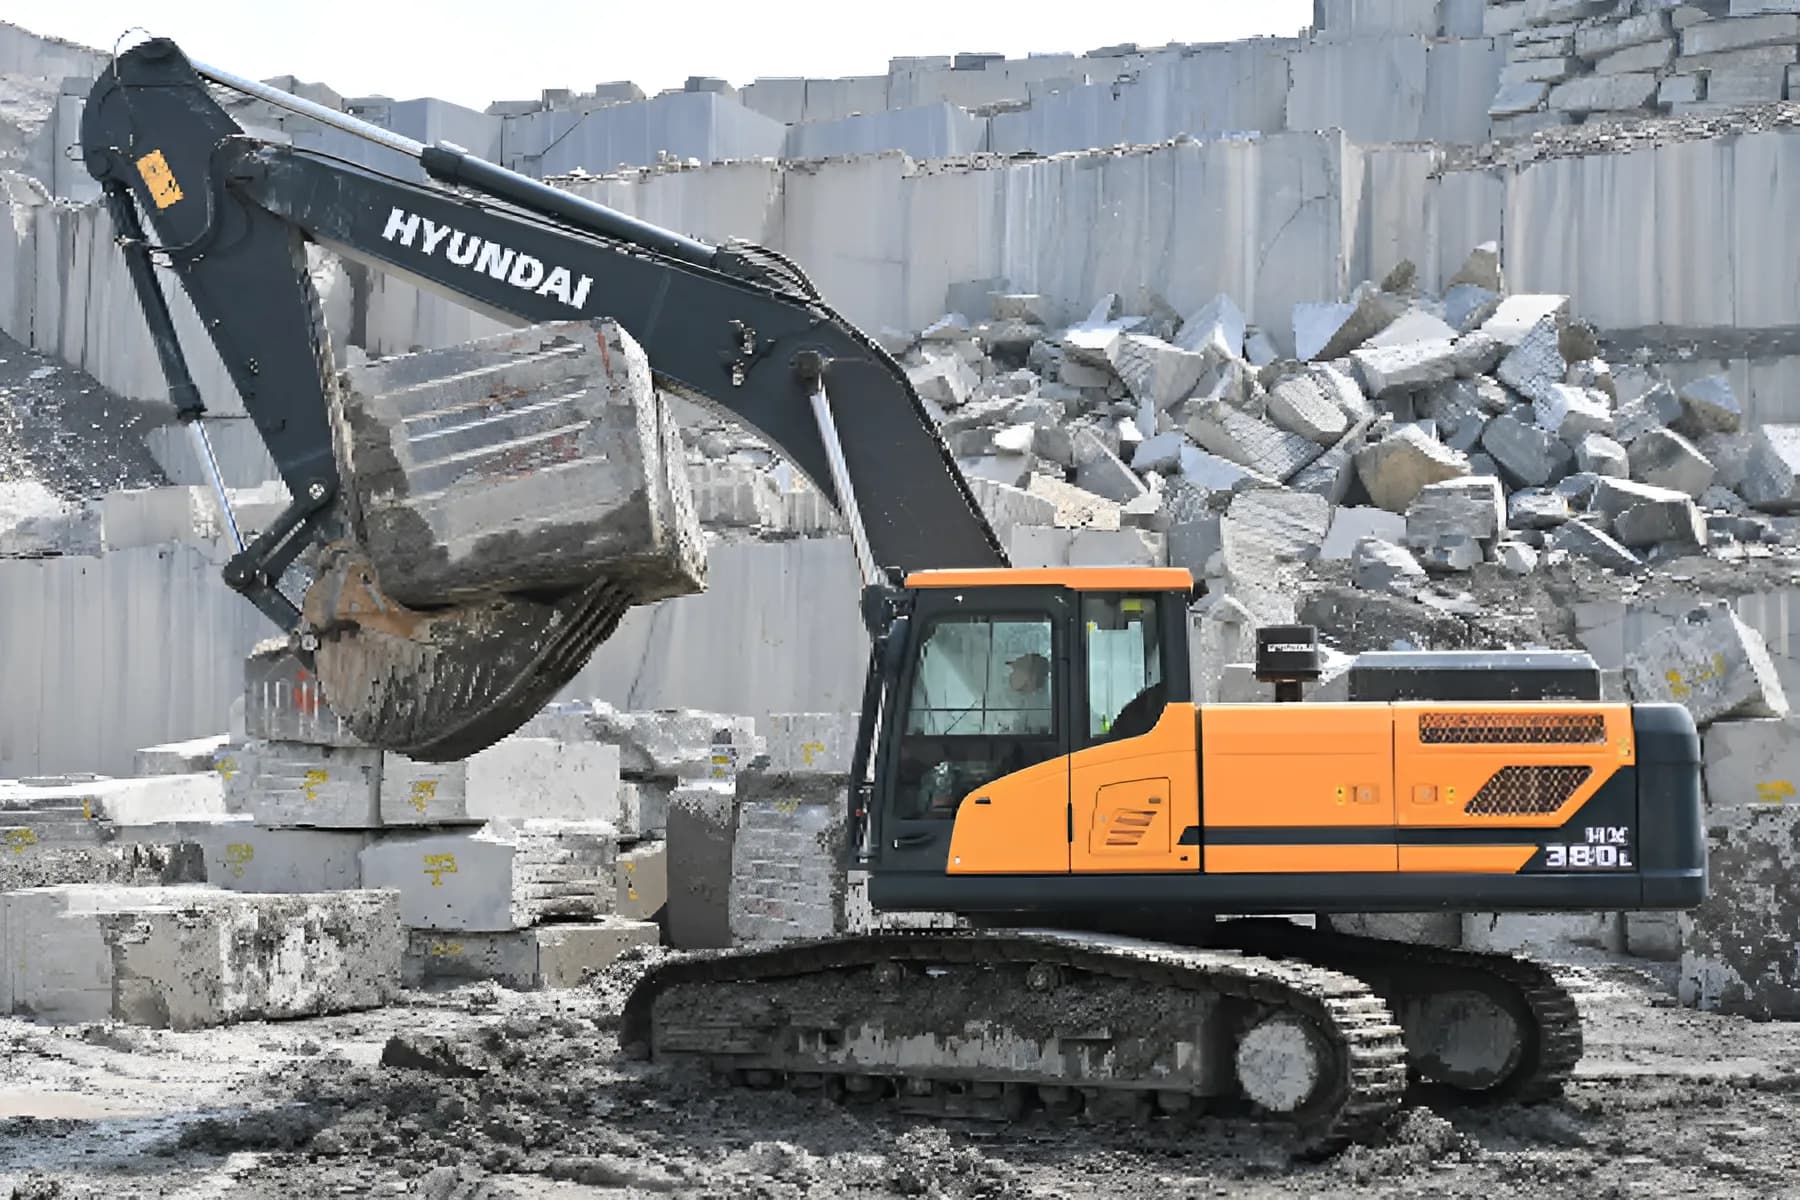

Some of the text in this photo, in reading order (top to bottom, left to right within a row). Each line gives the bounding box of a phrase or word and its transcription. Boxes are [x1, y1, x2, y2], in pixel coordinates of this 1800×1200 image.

[381, 206, 593, 310] HYUNDAI
[1585, 826, 1628, 844] HX
[1545, 845, 1632, 867] 380L
